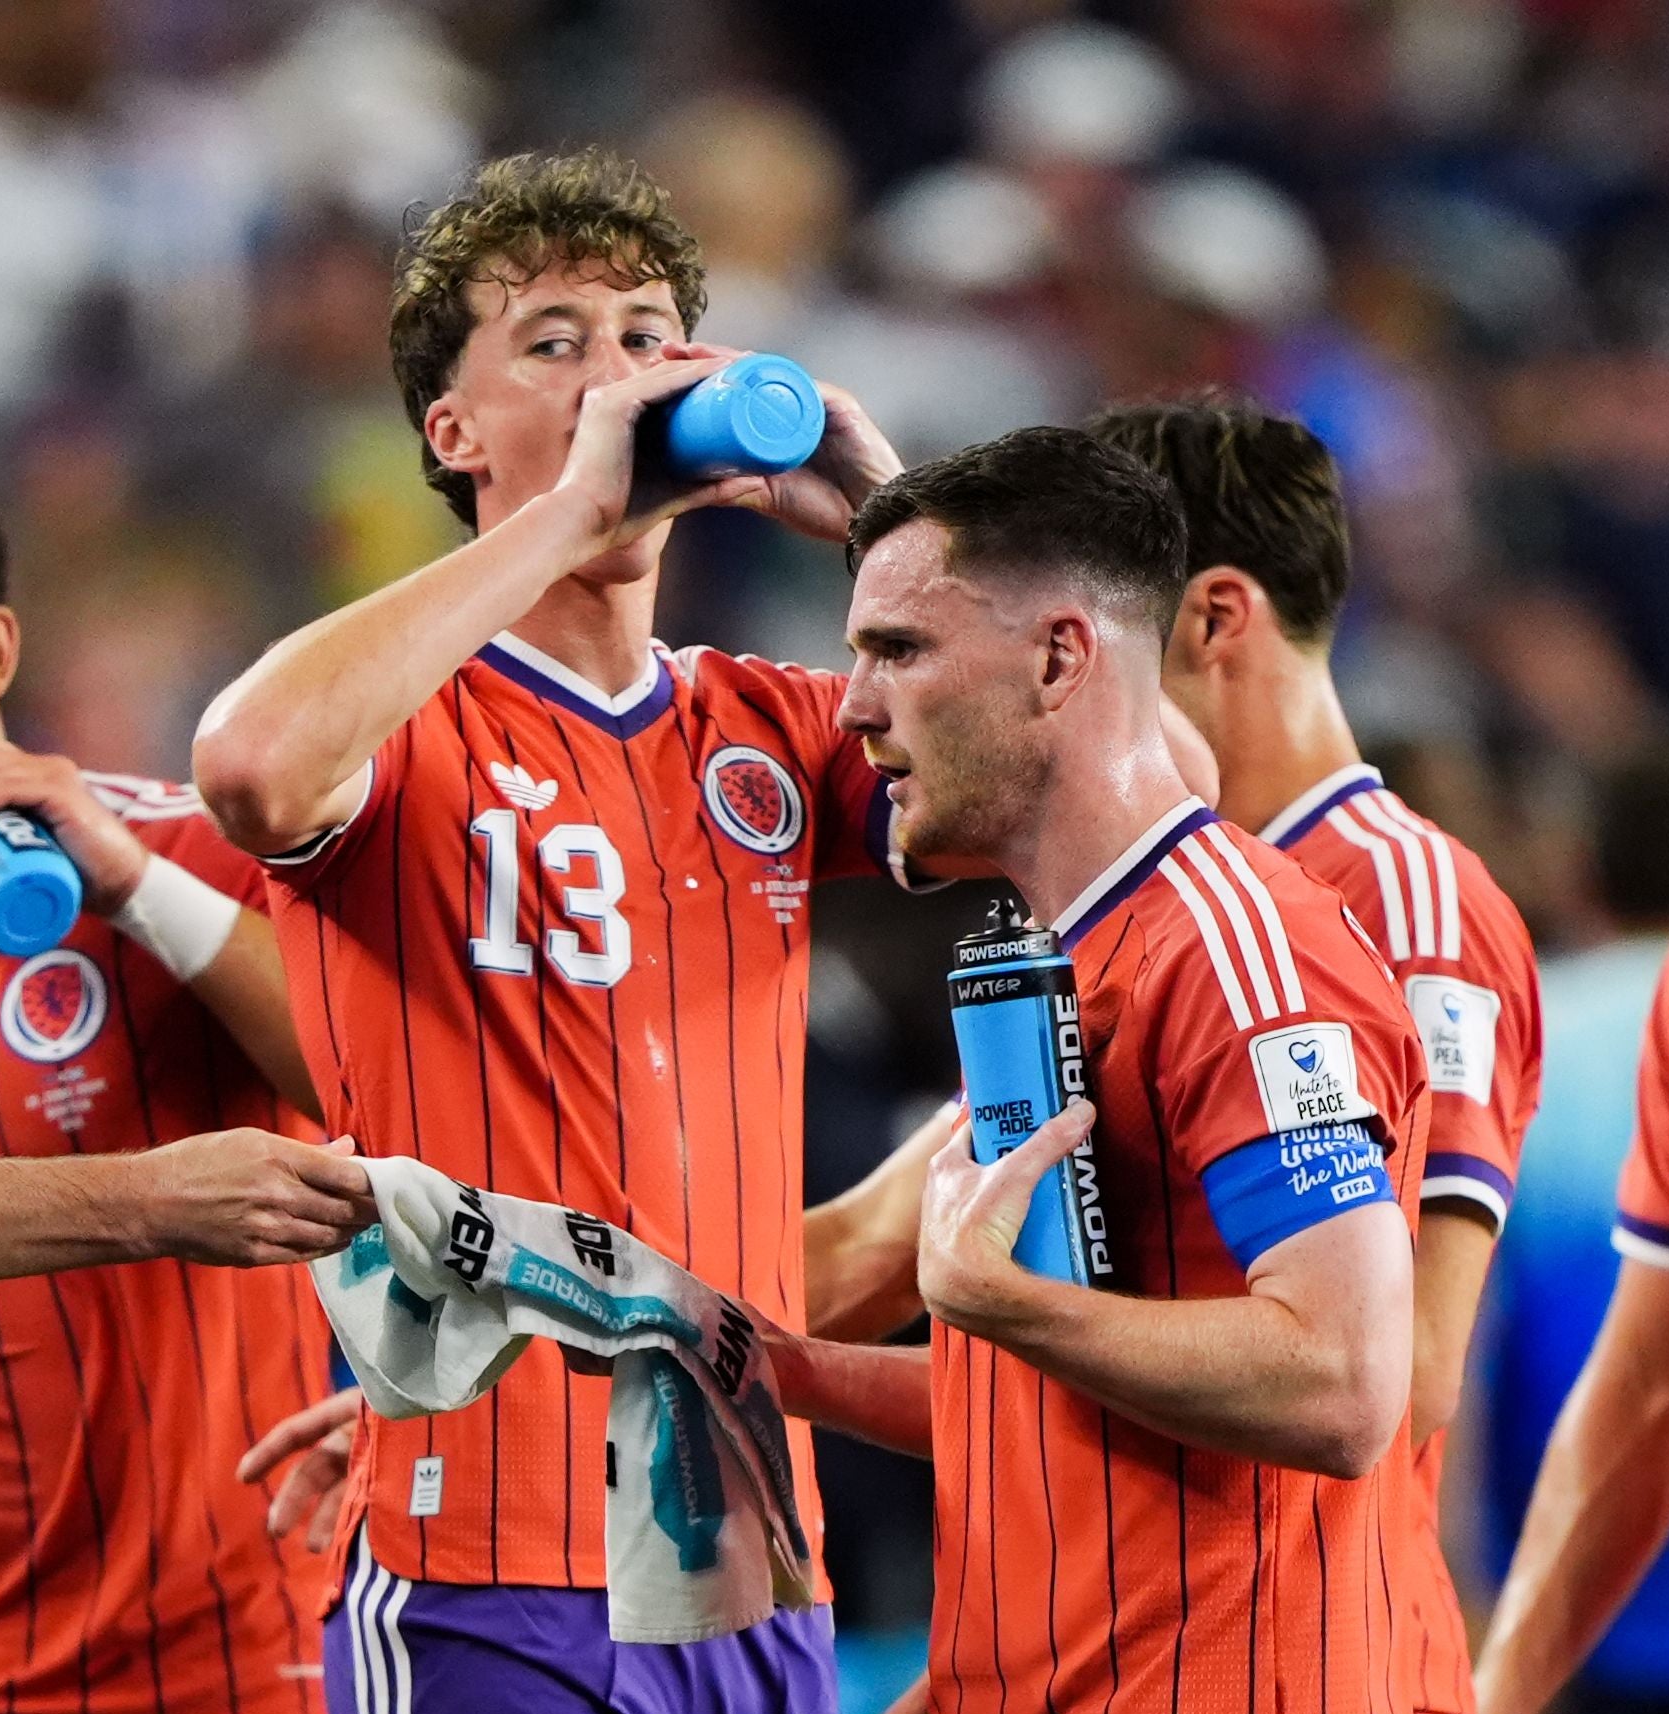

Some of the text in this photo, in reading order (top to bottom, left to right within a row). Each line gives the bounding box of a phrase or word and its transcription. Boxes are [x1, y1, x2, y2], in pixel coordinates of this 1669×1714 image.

[469, 808, 632, 988] 13
[959, 938, 1040, 964] POWERADE
[957, 977, 1022, 1001] WATER
[1433, 1047, 1464, 1066] PEA
[1321, 1072, 1342, 1090] Fo
[975, 1099, 1033, 1124] POWER
[1297, 1092, 1347, 1120] PEACE
[999, 1116, 1035, 1137] ADE
[1054, 993, 1114, 1275] POWEADE
[1286, 1166, 1332, 1196] the
[1329, 1143, 1385, 1179] World
[1337, 1180, 1371, 1199] FIFA
